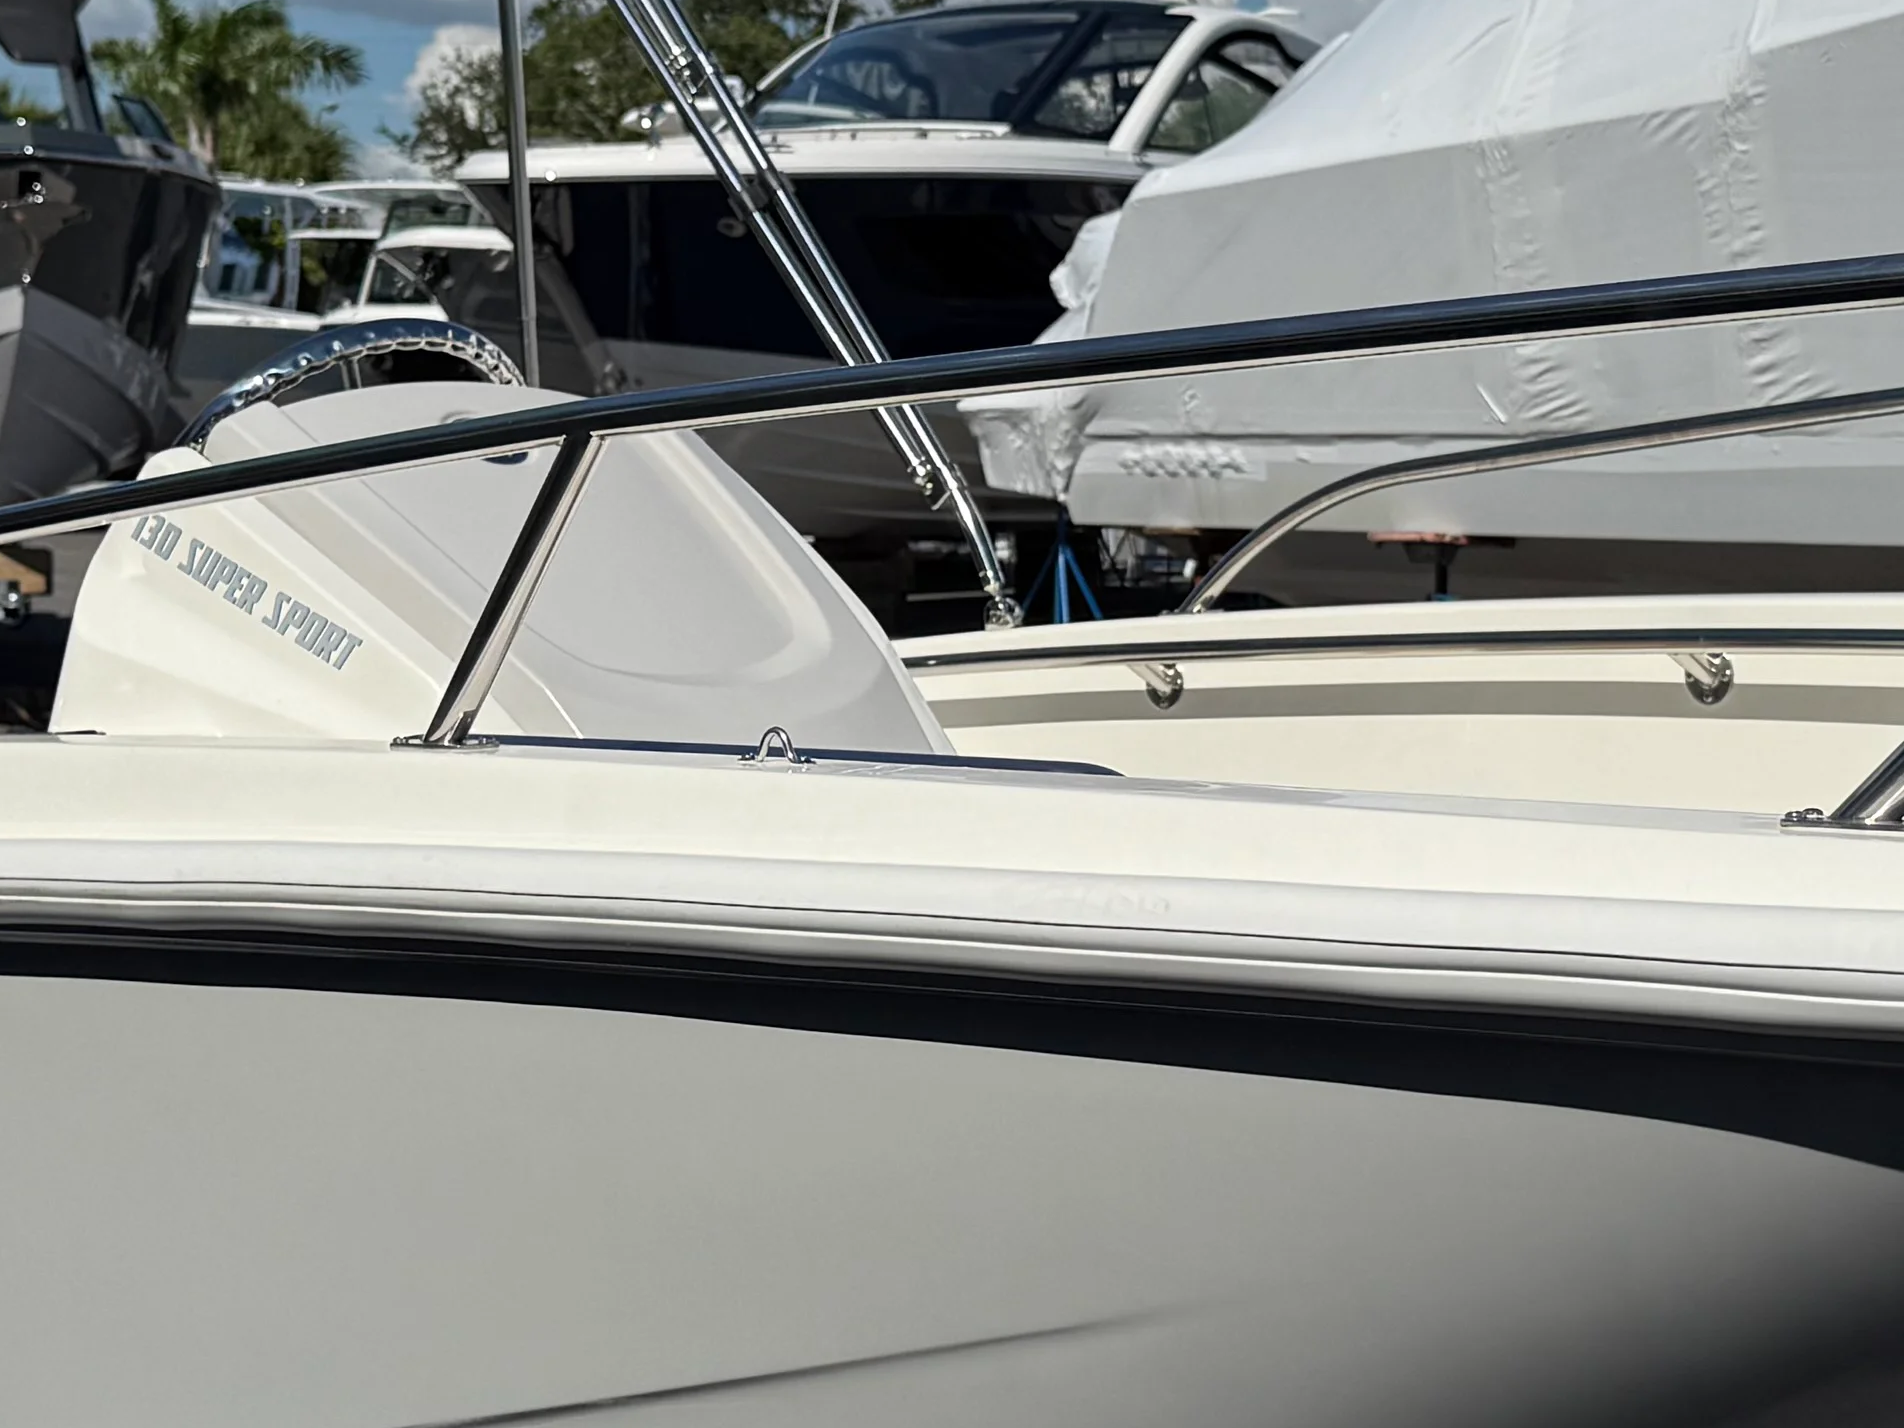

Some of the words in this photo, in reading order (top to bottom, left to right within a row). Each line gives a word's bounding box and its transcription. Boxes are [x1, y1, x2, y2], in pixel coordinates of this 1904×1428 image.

[130, 514, 183, 561] 130
[176, 538, 268, 615] SUPER
[261, 591, 364, 670] SPORT
